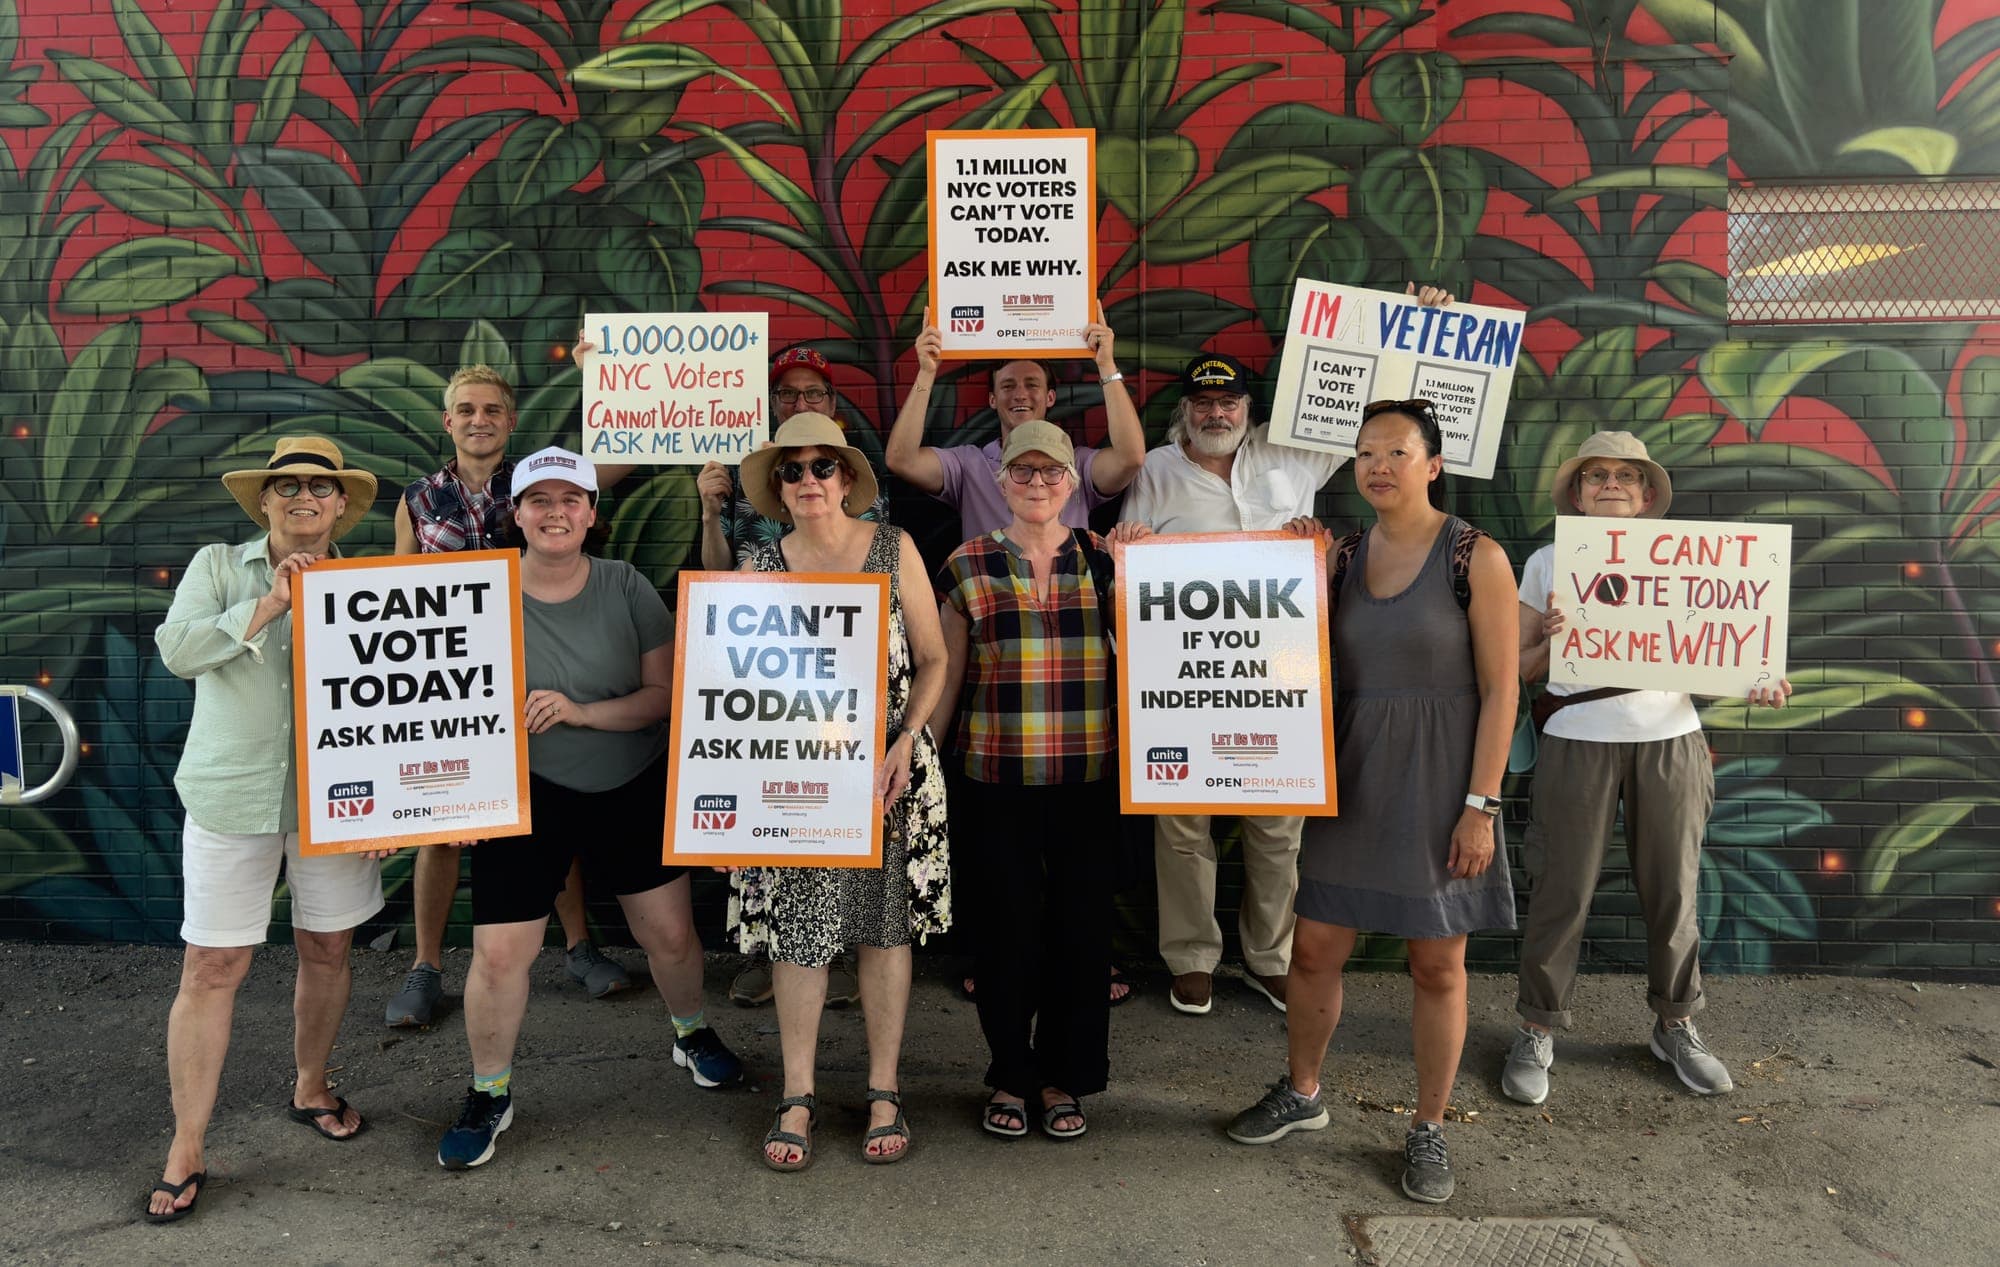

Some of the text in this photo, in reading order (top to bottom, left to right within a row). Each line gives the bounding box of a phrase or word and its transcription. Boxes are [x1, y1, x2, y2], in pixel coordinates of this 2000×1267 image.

[956, 158, 1067, 175] 1.1 MILLION
[948, 181, 1077, 198] NYC VOTERS
[950, 204, 1074, 221] CAN'T VOTE
[975, 227, 1049, 243] TODAY.
[944, 259, 1082, 277] ASK ME WHY.
[955, 308, 979, 317] unite
[951, 319, 984, 332] NY
[1300, 291, 1521, 368] I'M A VETERAN
[598, 323, 759, 357] 1,000,000+
[599, 362, 745, 391] NYC Voters
[1313, 360, 1366, 378] I CAN'T
[1319, 378, 1355, 394] VOTE
[1426, 379, 1474, 393] 1.1 MILLION
[1307, 394, 1360, 413] TODAY!
[1419, 389, 1476, 405] NYC VOTERS
[708, 397, 762, 427] TODAY!
[1434, 413, 1459, 424] ODAY.
[1449, 405, 1473, 415] VOTE
[1301, 413, 1360, 429] ASK ME WHY.
[591, 429, 754, 454] ASK ME WHY!
[1446, 431, 1470, 441] WHY.
[1605, 530, 1758, 567] I CAN'T
[1139, 577, 1305, 622] HONK
[1571, 572, 1770, 610] VOTE TODAY
[324, 582, 490, 625] I CAN'T
[706, 604, 862, 637] I CAN'T
[349, 626, 468, 665] VOTE
[1182, 630, 1260, 650] IF YOU
[1562, 628, 1622, 661] ASK
[1627, 630, 1662, 663] ME
[726, 646, 836, 679] VOTE
[1177, 659, 1267, 680] ARE AN
[322, 664, 493, 710] TODAY!
[698, 688, 858, 723] TODAY!
[1141, 688, 1308, 709] INDEPENDENT
[317, 714, 506, 750] ASK ME WHY.
[1211, 733, 1231, 746] LET
[1250, 733, 1278, 746] VOTE
[688, 738, 866, 761] ASK ME WHY.
[1152, 749, 1183, 760] unite
[400, 763, 420, 776] LET
[440, 758, 470, 772] VOTE
[1147, 764, 1189, 780] NY
[334, 784, 367, 797] unite
[762, 780, 783, 794] LET
[801, 781, 829, 795] VOTE
[1205, 777, 1316, 789] OPENPRIMARIES
[329, 799, 374, 818] NY
[392, 799, 509, 820] OPENPRIMARIES
[700, 797, 732, 809] unite
[693, 812, 736, 830] NY
[752, 827, 863, 839] OPENPRIMARIES
